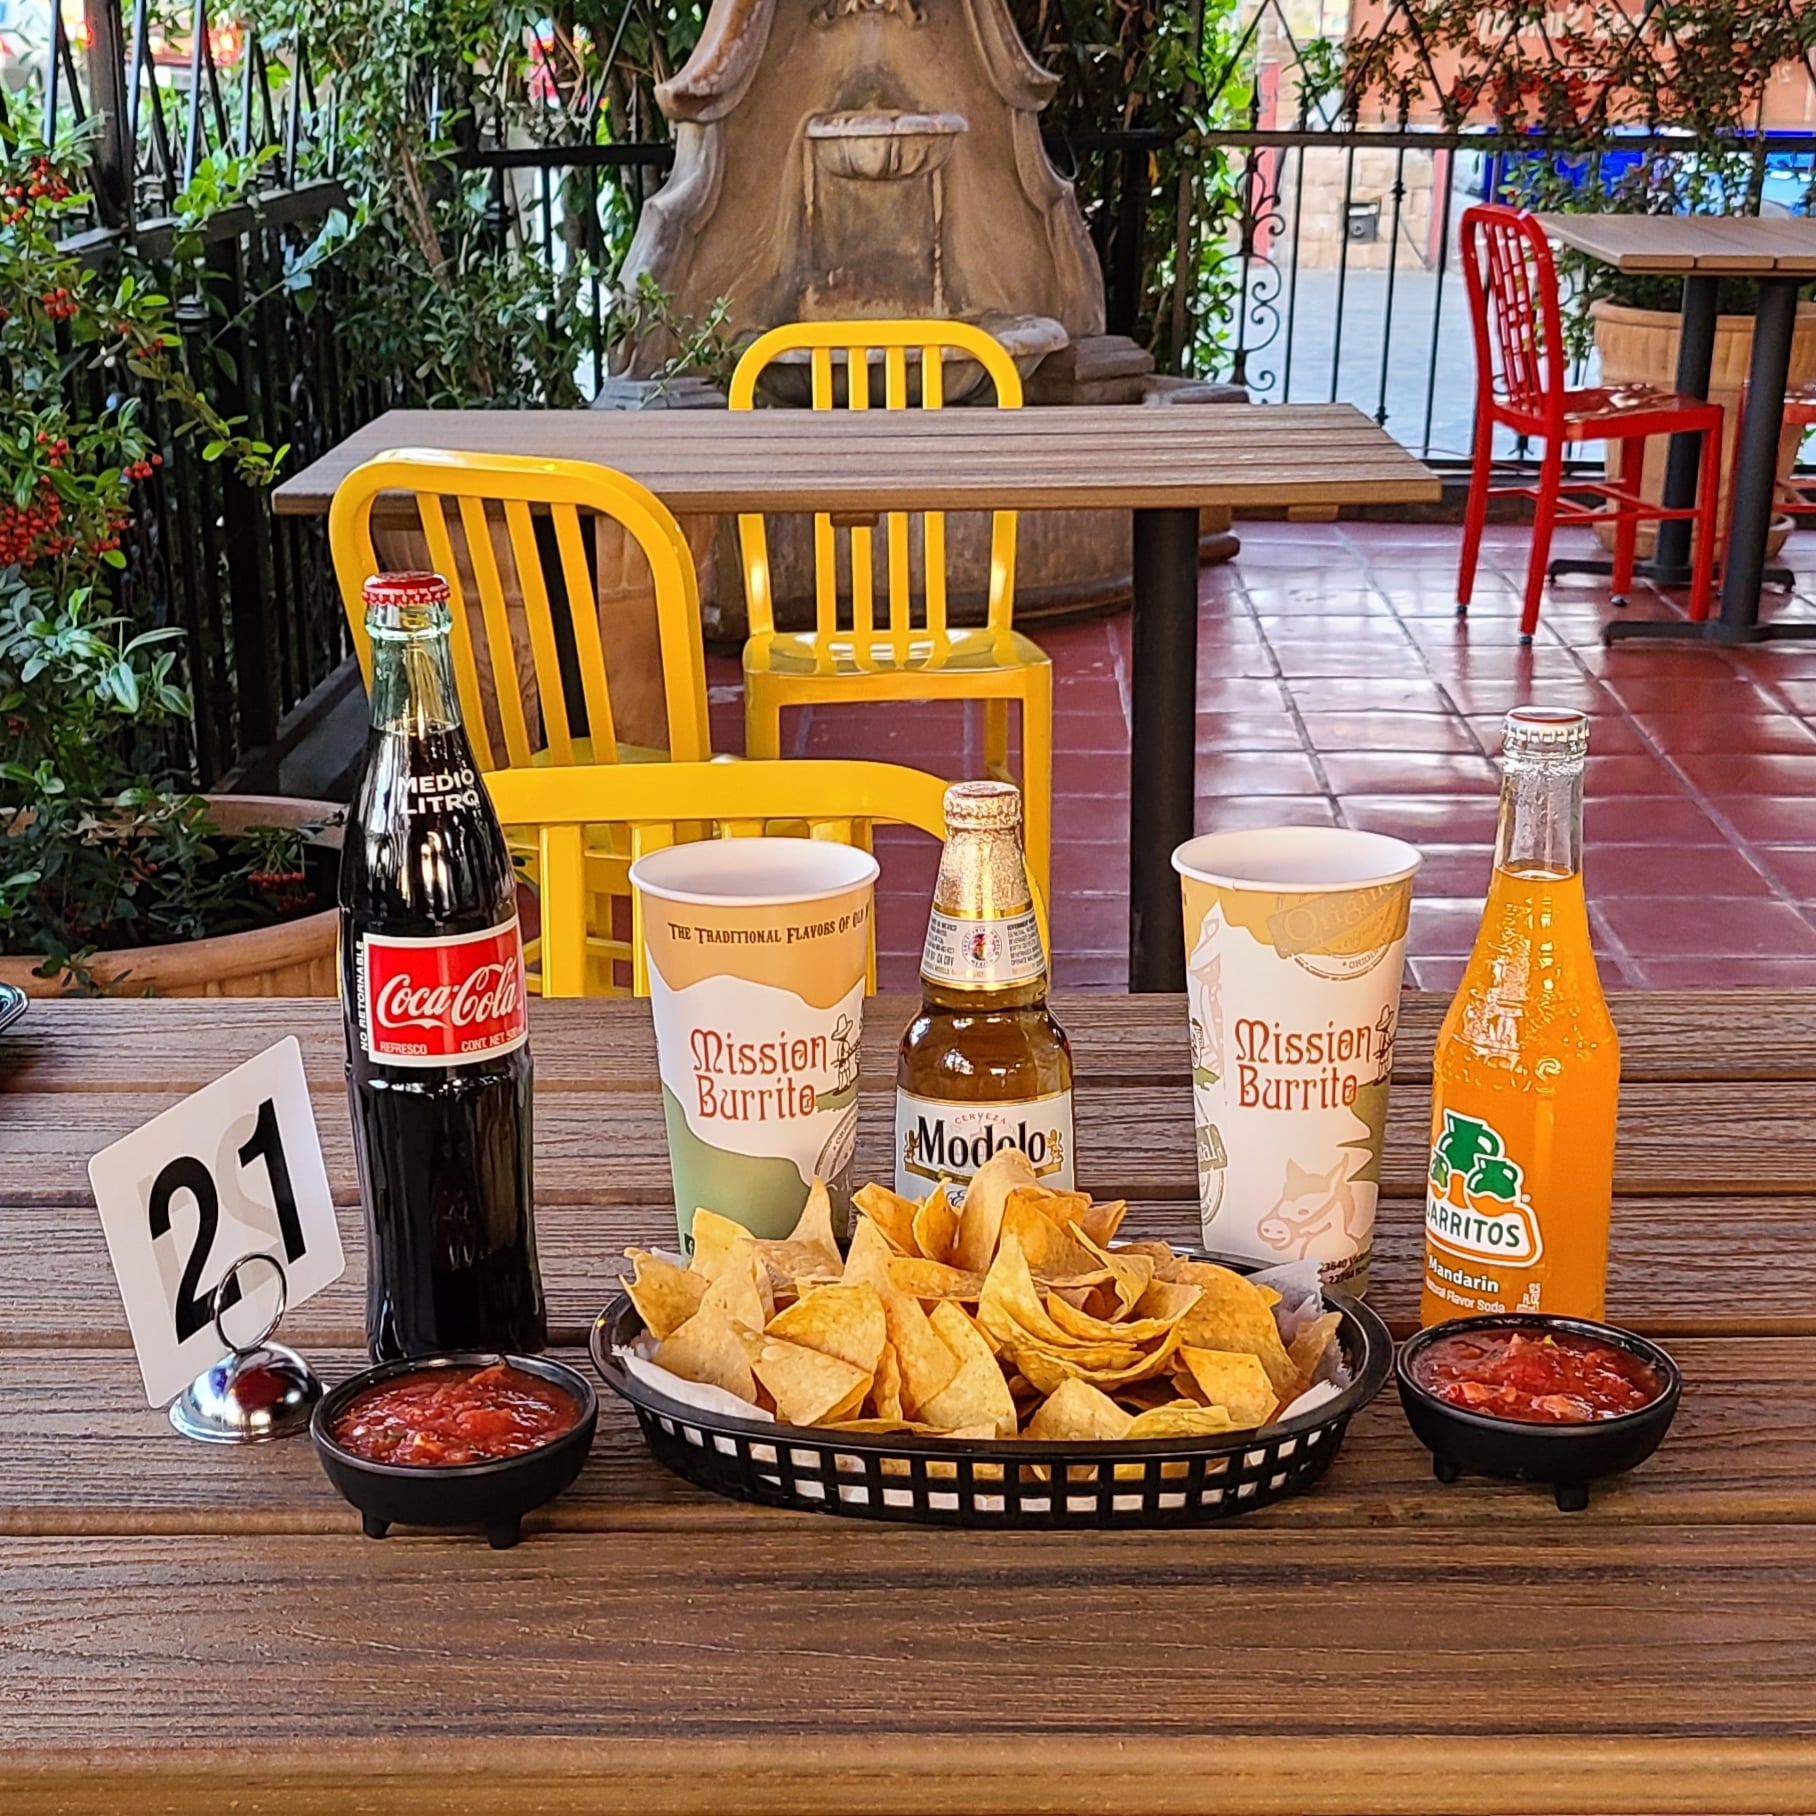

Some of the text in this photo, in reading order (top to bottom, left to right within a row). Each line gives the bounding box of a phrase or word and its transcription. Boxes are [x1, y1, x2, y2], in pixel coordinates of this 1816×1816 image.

[398, 769, 475, 794] MEDIO
[400, 789, 480, 815] LITRO
[667, 921, 692, 941] THE
[694, 926, 783, 945] TRADITIONAL
[786, 920, 836, 945] FLAVORS
[838, 914, 851, 934] OF
[356, 940, 370, 1052] NO RETORNABLE
[376, 956, 517, 1030] Coca-Cola
[379, 1041, 428, 1056] REFRESCO
[489, 1031, 505, 1047] NET
[690, 1028, 828, 1075] Mission
[1234, 1018, 1372, 1066] Mission
[695, 1073, 818, 1121] Burrito
[1237, 1063, 1358, 1111] Burrito
[954, 1111, 1007, 1126] CERVEZA
[148, 1096, 308, 1345] 21
[1427, 1254, 1500, 1293] Mandarin
[1446, 1290, 1476, 1309] Flavor
[1476, 1299, 1506, 1314] Soda
